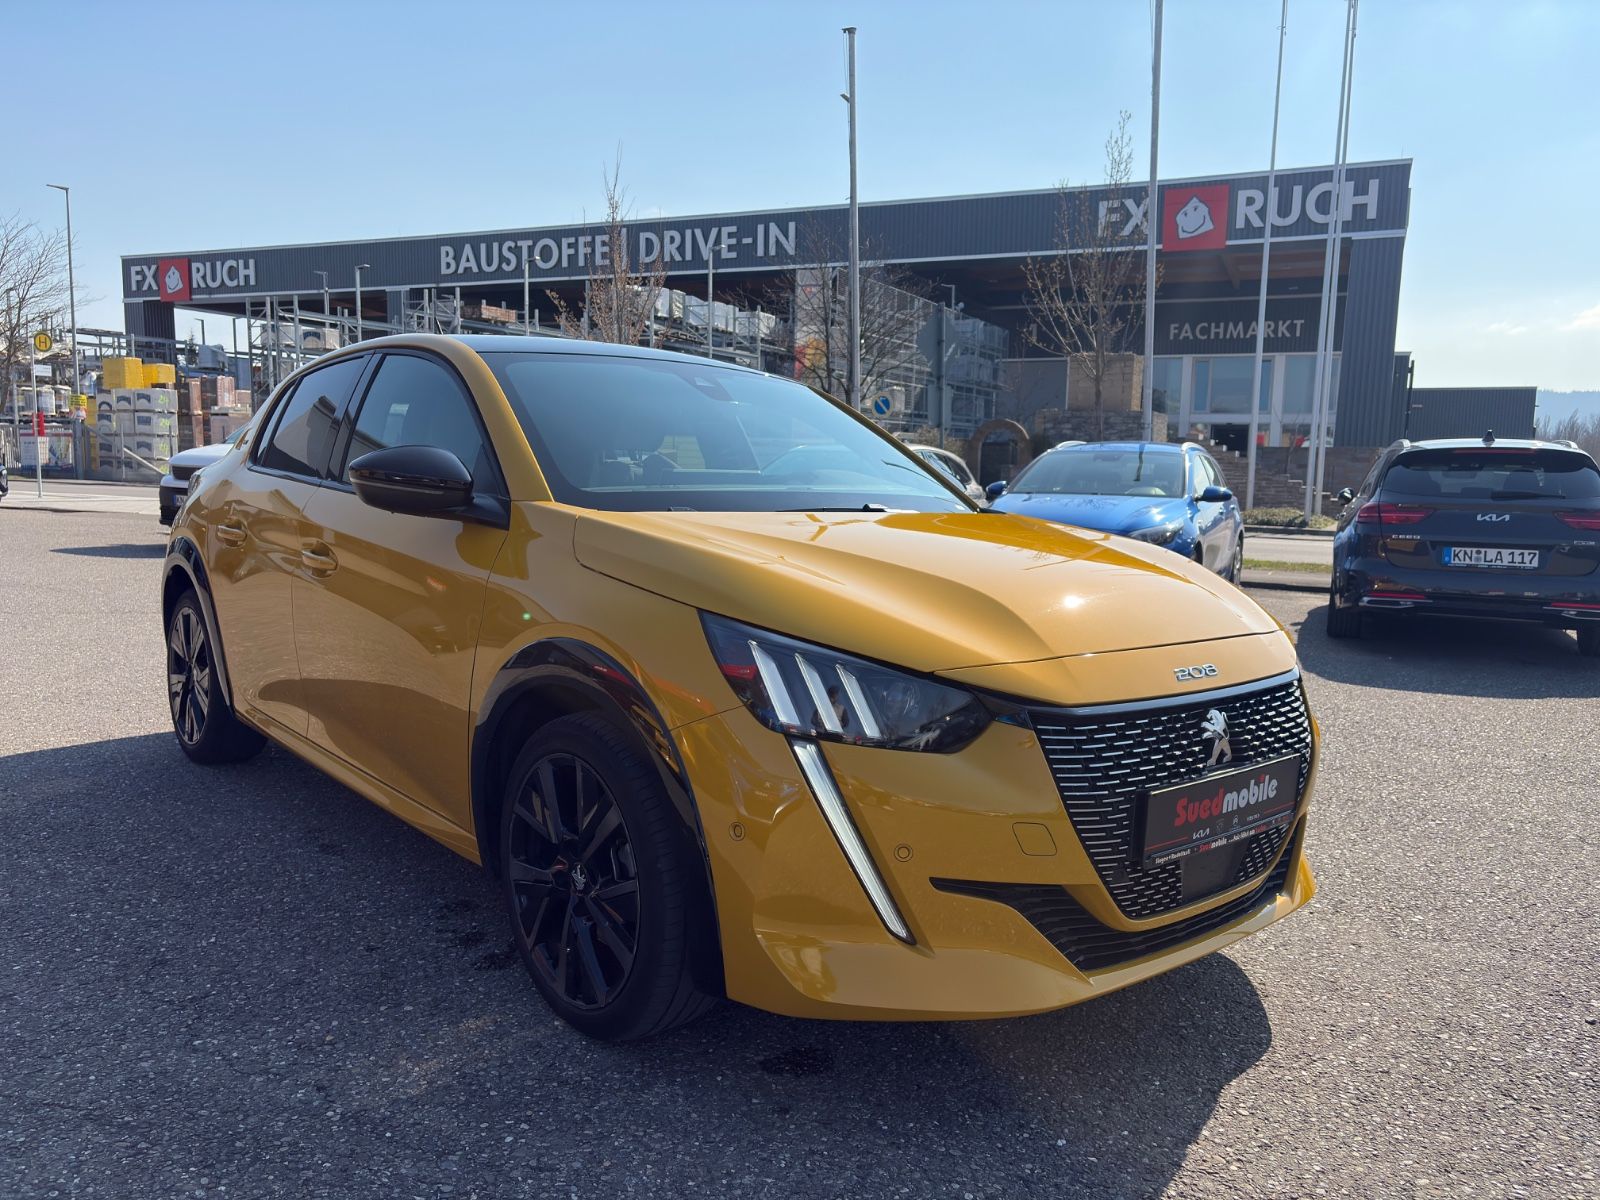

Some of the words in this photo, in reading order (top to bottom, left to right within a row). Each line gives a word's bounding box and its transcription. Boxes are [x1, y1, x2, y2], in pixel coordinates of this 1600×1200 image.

[1097, 197, 1149, 238] FX
[1235, 179, 1379, 229] RUCH
[440, 234, 611, 275] BAUSTOFFE
[639, 221, 797, 264] DRIVE-IN
[130, 264, 159, 291] FX
[191, 258, 257, 289] RUCH
[38, 336, 48, 349] H
[1169, 319, 1305, 341] FACHMARKT
[1452, 549, 1473, 562] KN
[1483, 550, 1504, 564] LA
[1508, 551, 1537, 565] 117
[1173, 663, 1219, 682] 208
[1174, 774, 1278, 827] Suedmobile
